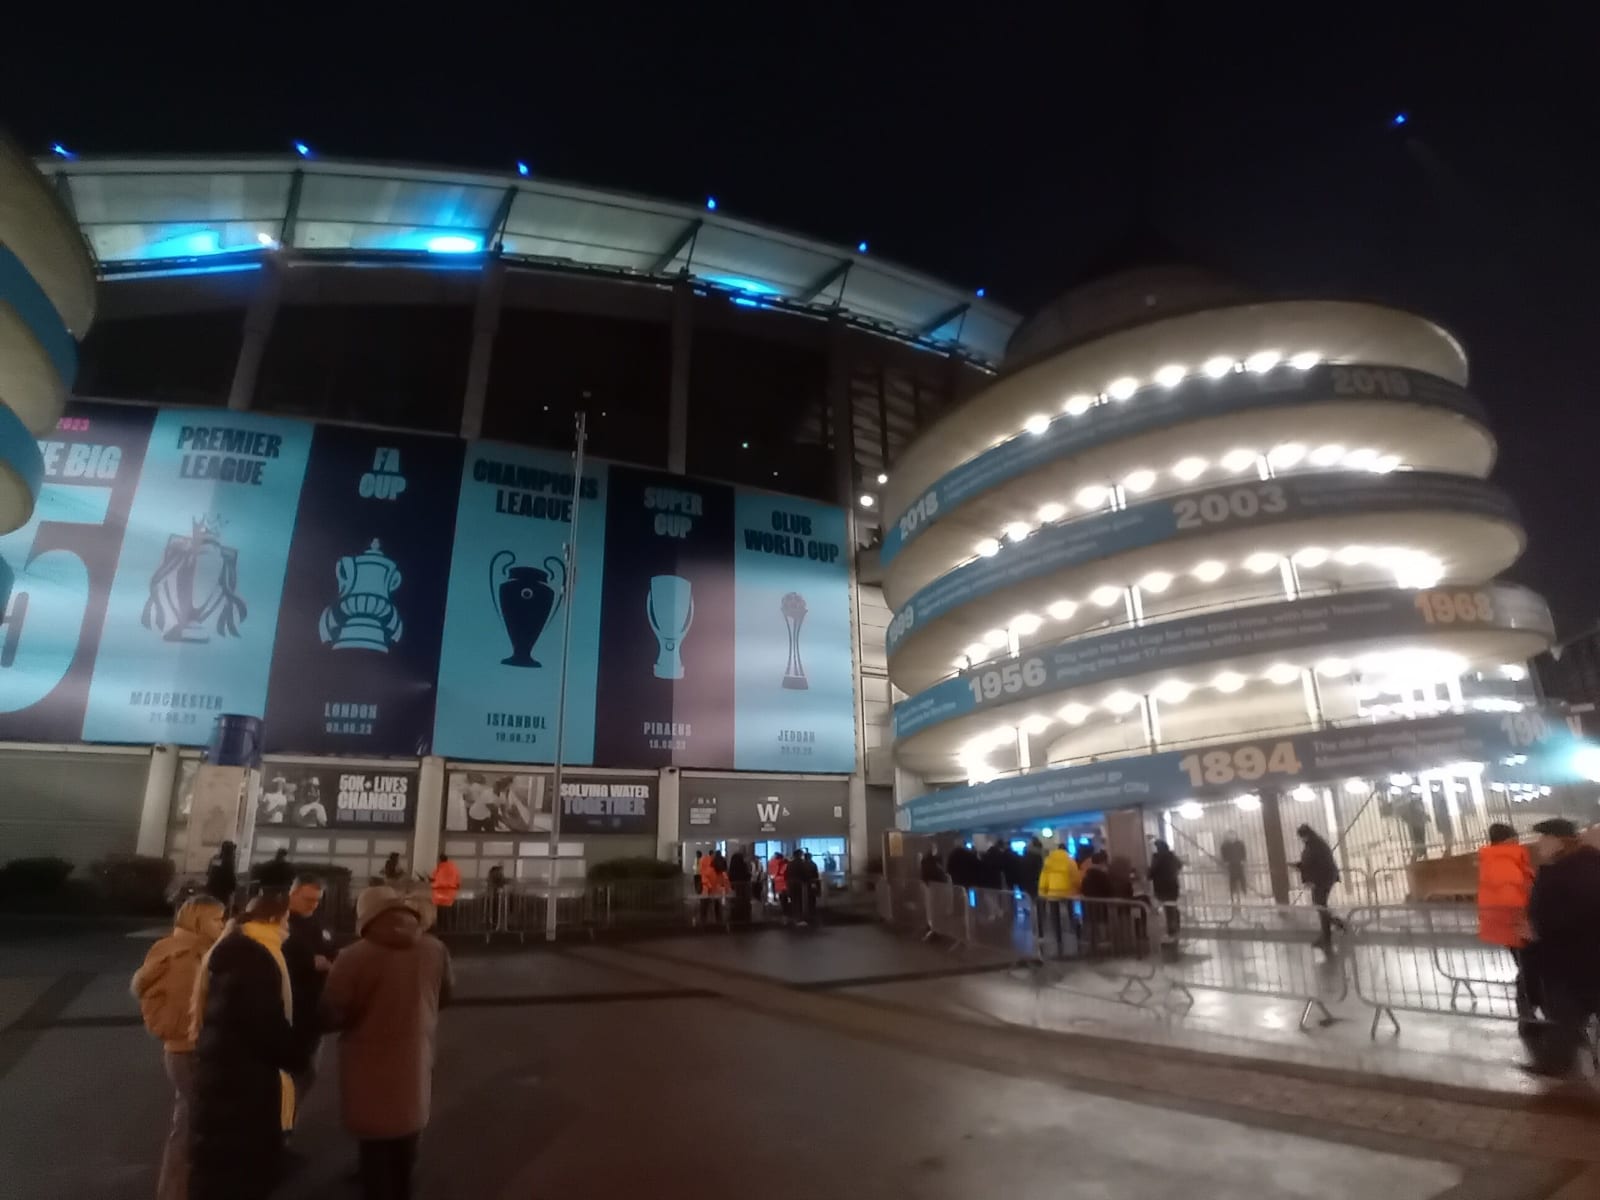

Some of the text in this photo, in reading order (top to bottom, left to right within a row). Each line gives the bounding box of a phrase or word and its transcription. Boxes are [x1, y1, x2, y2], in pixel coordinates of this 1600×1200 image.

[178, 426, 282, 458] PREMIER
[63, 443, 121, 478] BIG
[179, 455, 267, 485] LEAGUE
[373, 448, 400, 472] FA
[359, 472, 406, 500] CUP
[473, 459, 598, 499] CHAMPIONS
[496, 489, 574, 522] LEAGUE
[644, 486, 703, 516] SUPER
[1173, 485, 1287, 528] 2003
[654, 512, 692, 538] CUP
[772, 510, 811, 535] CLUB
[900, 491, 938, 540] 2018
[744, 529, 839, 562] WORLD CUP
[969, 658, 1047, 703] 1956
[130, 691, 223, 710] MANCHESTER
[325, 703, 377, 719] LONDON
[487, 713, 546, 729] ISTANBUL
[644, 722, 691, 737] PIRAEUS
[778, 729, 815, 743] JEDDAH
[1178, 741, 1302, 787] 1894
[374, 776, 408, 793] LIVES
[560, 783, 649, 799] SOLVING WATER
[337, 791, 406, 811] CHANGED
[563, 797, 646, 816] TOGETHER
[757, 803, 780, 822] W
